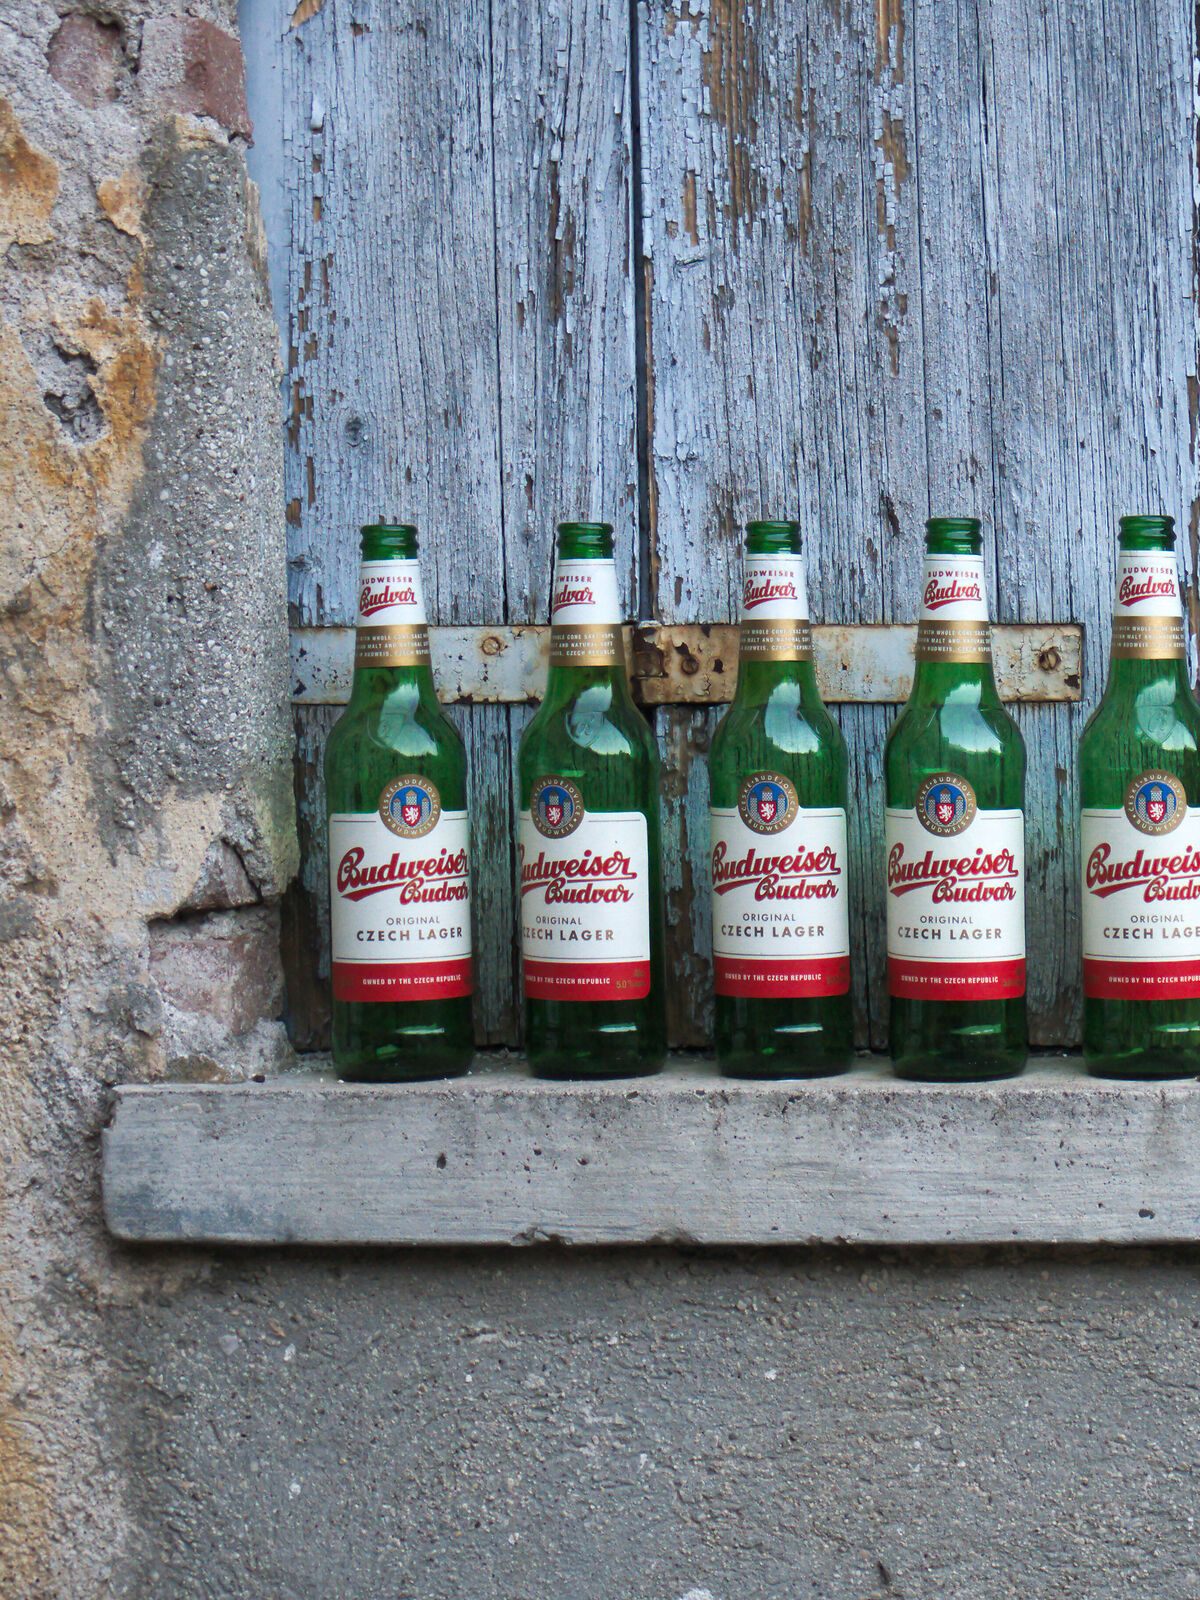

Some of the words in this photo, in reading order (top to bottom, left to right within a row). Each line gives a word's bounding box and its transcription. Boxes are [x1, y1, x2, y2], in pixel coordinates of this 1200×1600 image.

[928, 570, 979, 579] BUDWEISER
[1123, 566, 1173, 575] BUDWEISER
[743, 578, 798, 608] Budvar
[924, 579, 982, 609] Budvar
[1119, 575, 1177, 605] Budvar
[360, 585, 418, 615] Budvar
[336, 846, 470, 896] Budweiser
[712, 840, 842, 891] Budweiser
[888, 842, 1019, 892] Budweiser
[400, 876, 469, 906] Budvar
[545, 876, 634, 905] Budvar
[755, 873, 840, 902] Budvar
[932, 875, 1017, 904] Budvar
[386, 915, 441, 926] ORIGINAL
[535, 915, 583, 926] ORIGINAL
[742, 912, 796, 923] ORIGINAL
[919, 915, 974, 925] ORIGINAL
[1130, 914, 1185, 924] ORIGINAL
[356, 929, 410, 942] CZECH
[418, 927, 463, 941] LAGER
[559, 929, 615, 941] LAGER
[721, 924, 764, 938] CZECH
[772, 925, 825, 938] LAGER
[897, 926, 942, 940] CZECH
[949, 928, 1002, 940] LAGER
[1103, 927, 1154, 940] CZECH
[399, 977, 412, 985] THE
[413, 975, 435, 984] CZECH
[436, 973, 461, 983] REPUBLIC
[577, 977, 611, 985] REPUBLIC
[753, 973, 765, 981] THE
[767, 973, 789, 981] CZECH
[790, 973, 822, 981] REPUBLIC
[930, 976, 942, 984] THE
[944, 976, 966, 984] CZECH
[967, 975, 999, 984] REPUBLIC
[1157, 975, 1179, 983] CZECH
